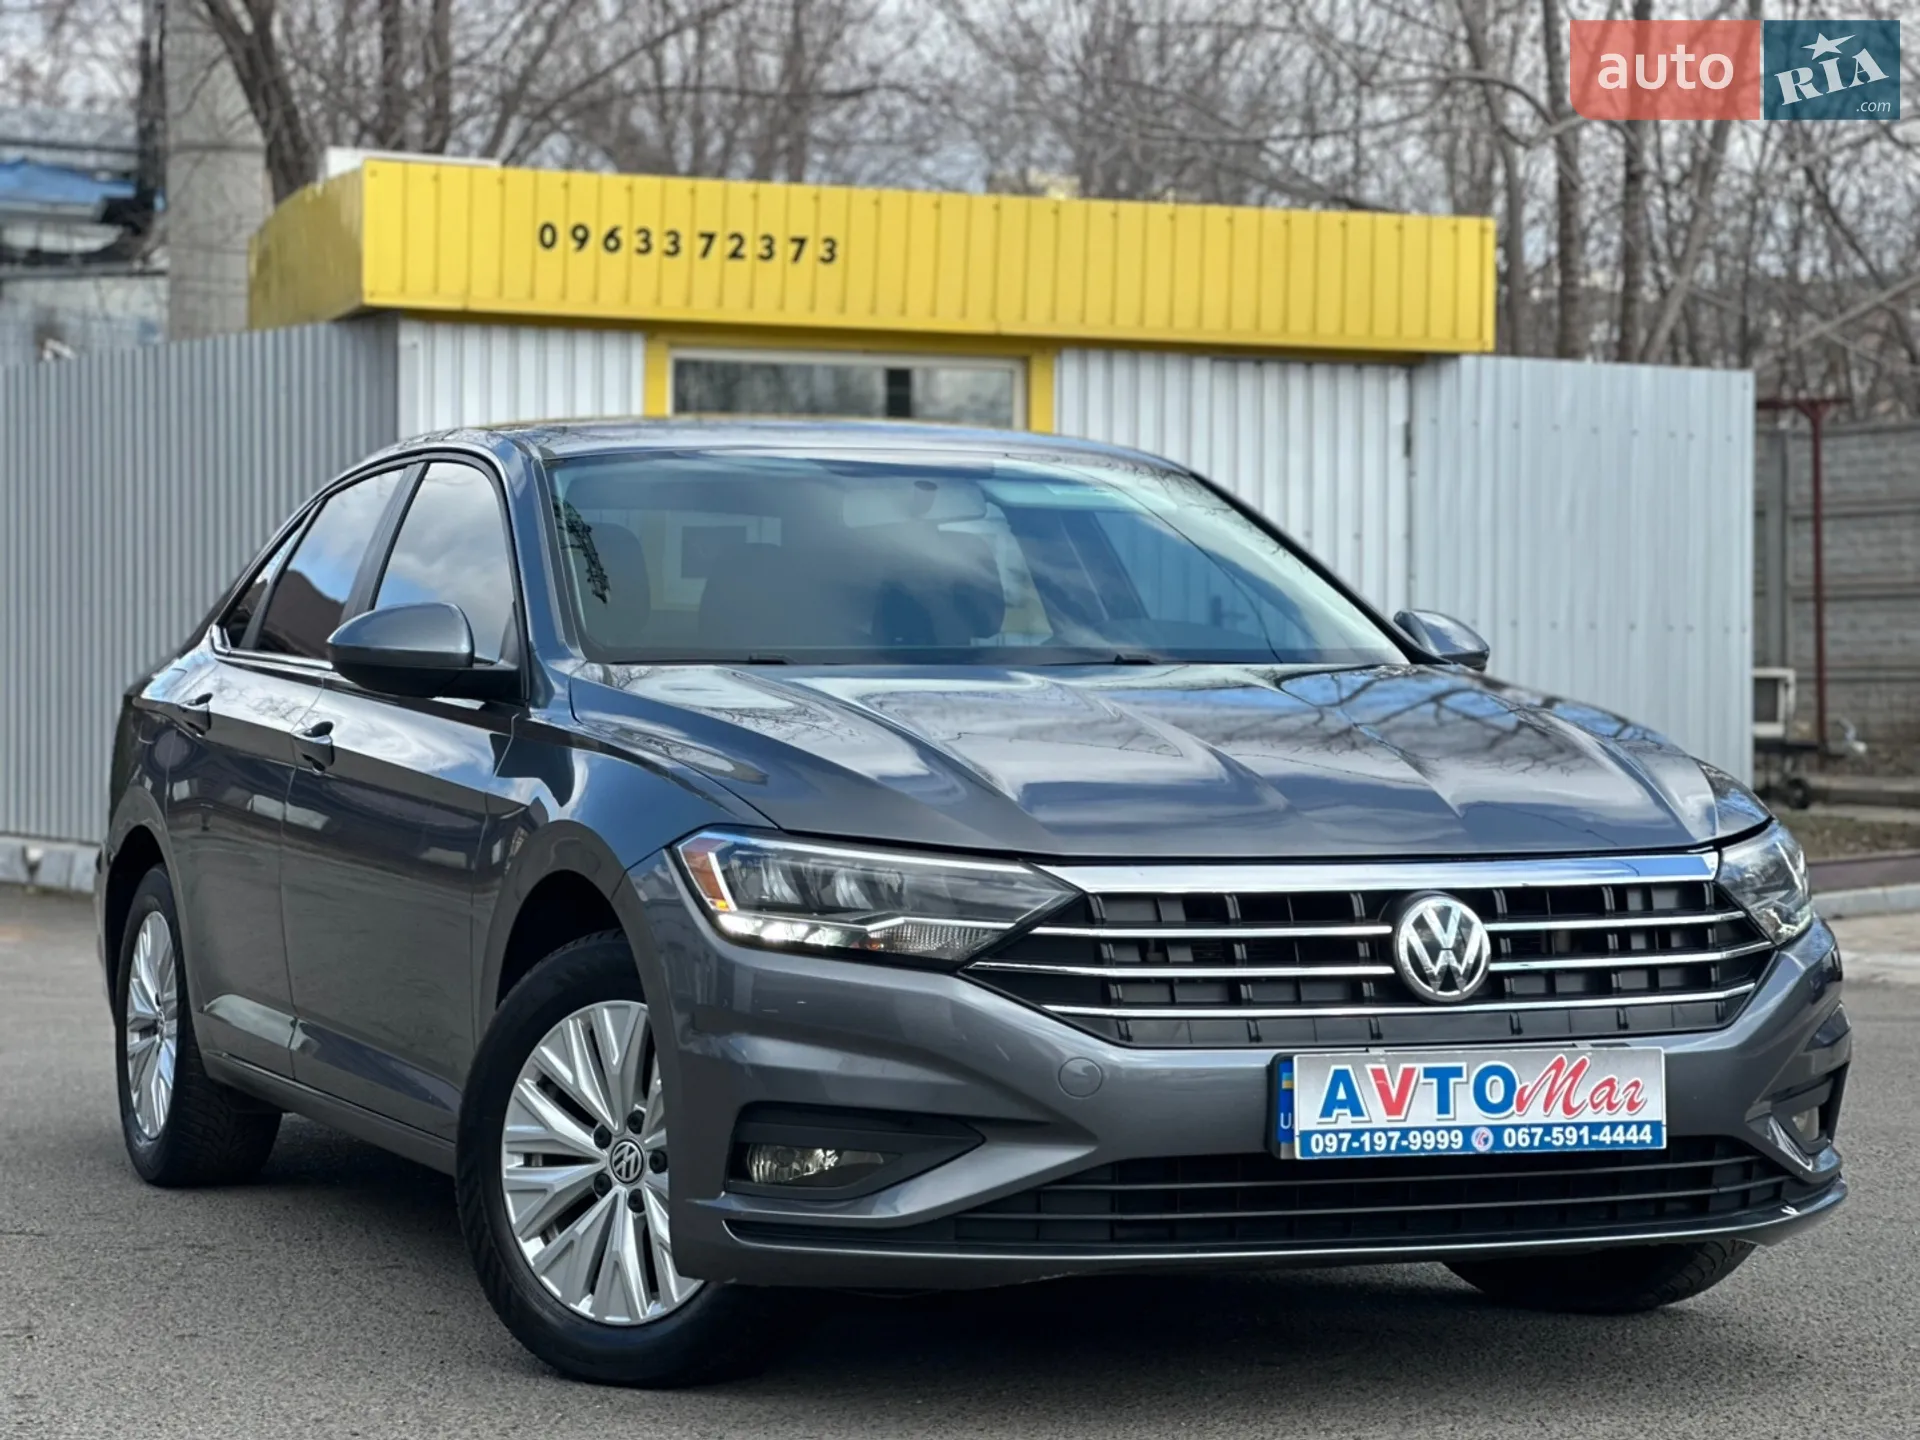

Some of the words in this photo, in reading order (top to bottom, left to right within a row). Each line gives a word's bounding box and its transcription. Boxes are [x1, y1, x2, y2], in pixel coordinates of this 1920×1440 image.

[539, 221, 839, 264] 0963372373
[1281, 1112, 1294, 1130] U
[1310, 1129, 1464, 1154] 097-197-9999
[1503, 1123, 1653, 1148] 067-591-4444
